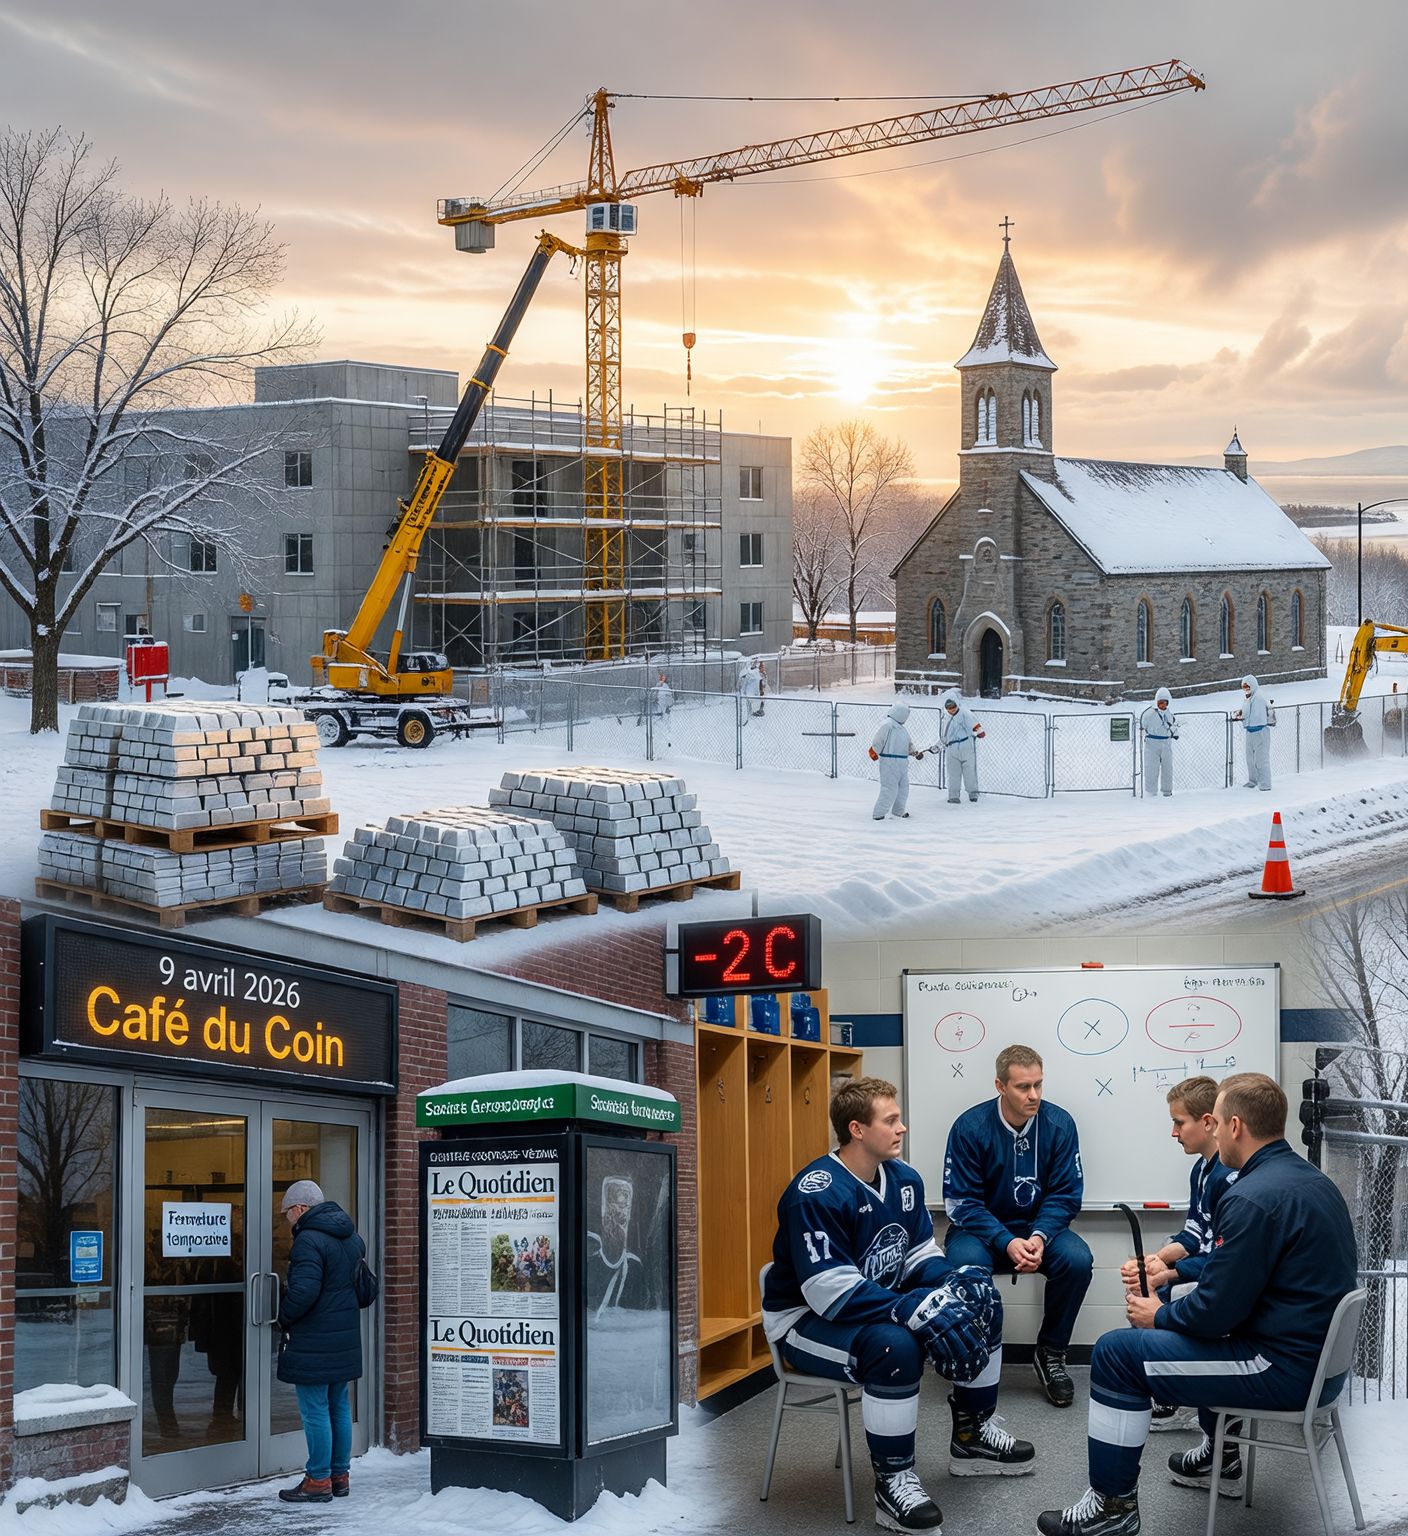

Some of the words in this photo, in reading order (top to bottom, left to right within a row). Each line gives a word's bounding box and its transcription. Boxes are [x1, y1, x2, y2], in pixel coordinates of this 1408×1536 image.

[694, 929, 751, 982] -2
[765, 926, 797, 978] C
[159, 956, 175, 986] 9
[183, 967, 235, 998] avril
[243, 972, 301, 1009] 2026
[86, 985, 190, 1046] Café
[203, 1006, 250, 1056] du
[264, 1015, 345, 1067] Coin
[431, 1172, 456, 1195] Le
[458, 1170, 555, 1200] Quotidien
[803, 1230, 832, 1264] 17
[430, 1319, 456, 1343] Le
[458, 1319, 556, 1349] Quotidien
